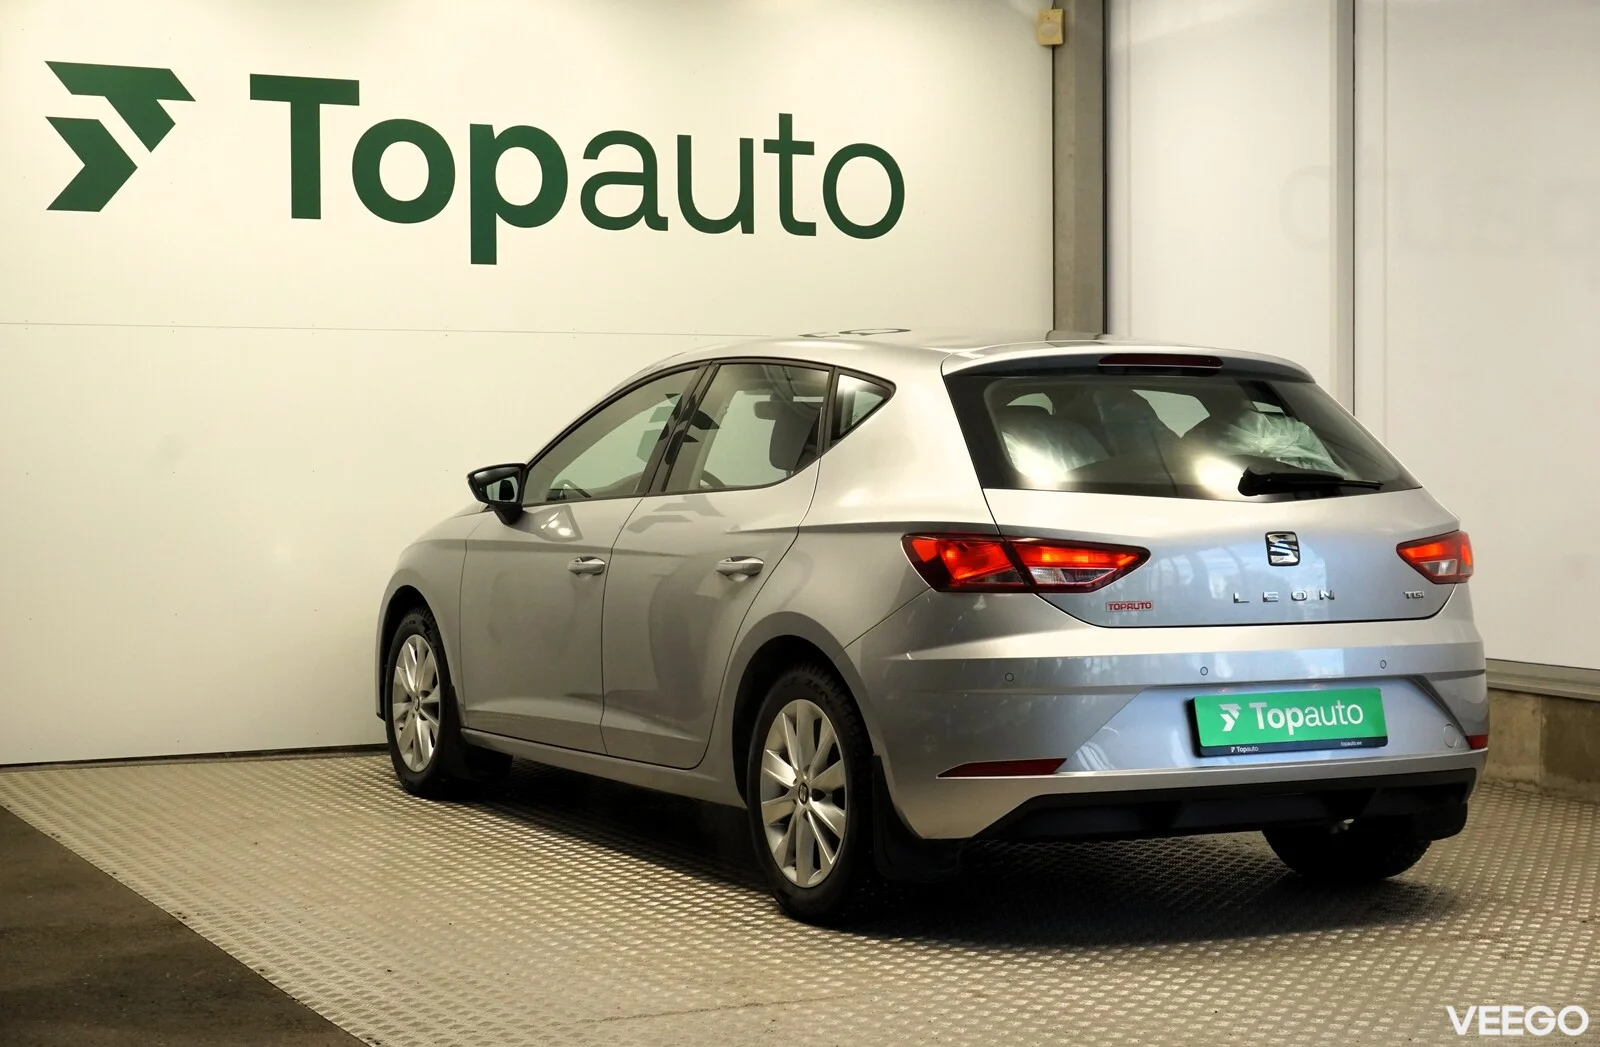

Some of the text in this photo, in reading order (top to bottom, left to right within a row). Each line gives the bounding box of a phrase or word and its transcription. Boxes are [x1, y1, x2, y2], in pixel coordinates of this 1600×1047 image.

[250, 73, 905, 265] Topauto
[1108, 602, 1152, 610] TOPAUTO
[1233, 589, 1336, 604] LEON
[1248, 700, 1364, 735] Topauto
